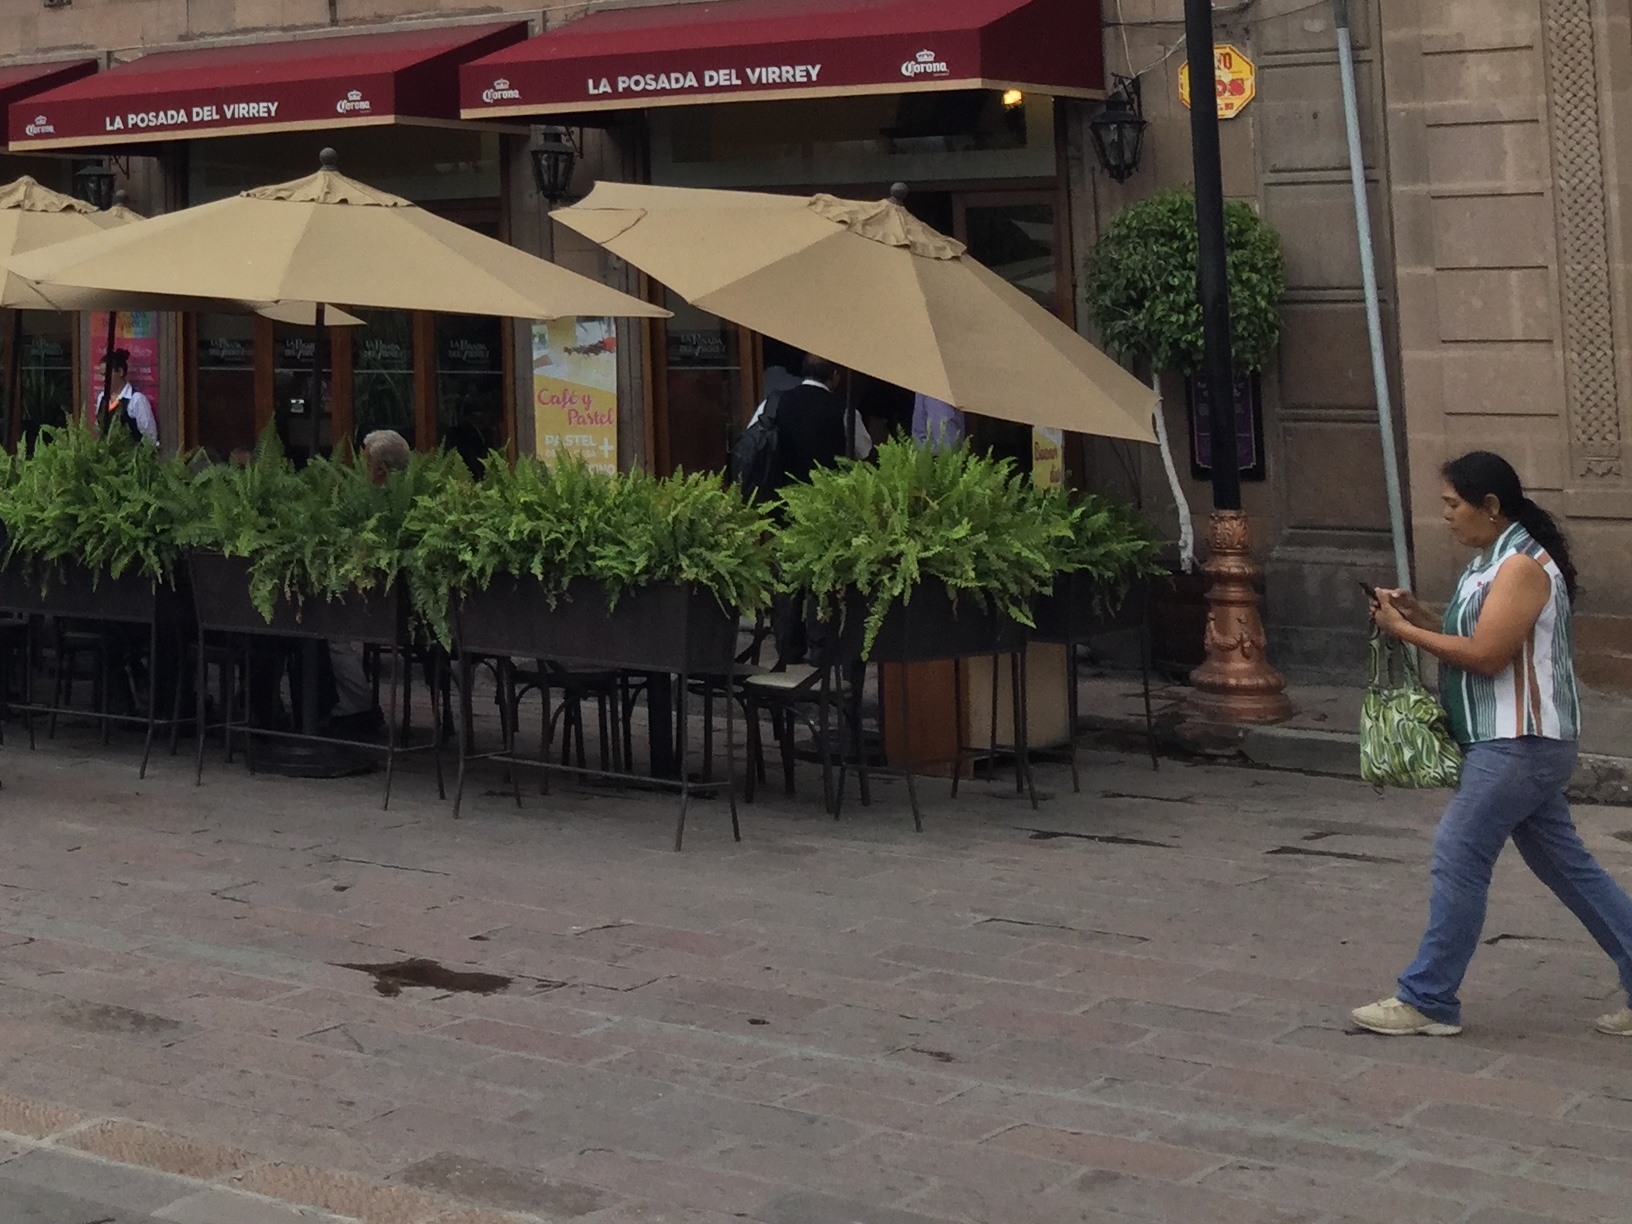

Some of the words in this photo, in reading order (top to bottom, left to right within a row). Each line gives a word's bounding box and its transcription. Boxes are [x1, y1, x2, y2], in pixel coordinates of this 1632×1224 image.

[901, 60, 948, 78] Corona
[588, 77, 612, 95] LA
[617, 71, 699, 93] POSADA
[704, 68, 742, 87] DEL
[745, 63, 821, 85] VIRREY
[482, 88, 521, 104] Corona
[336, 99, 371, 114] Corona
[105, 115, 124, 131] LA
[127, 108, 188, 129] POSADA
[192, 105, 220, 122] DEL
[223, 101, 279, 119] VIRREY
[567, 408, 613, 426] Pastel
